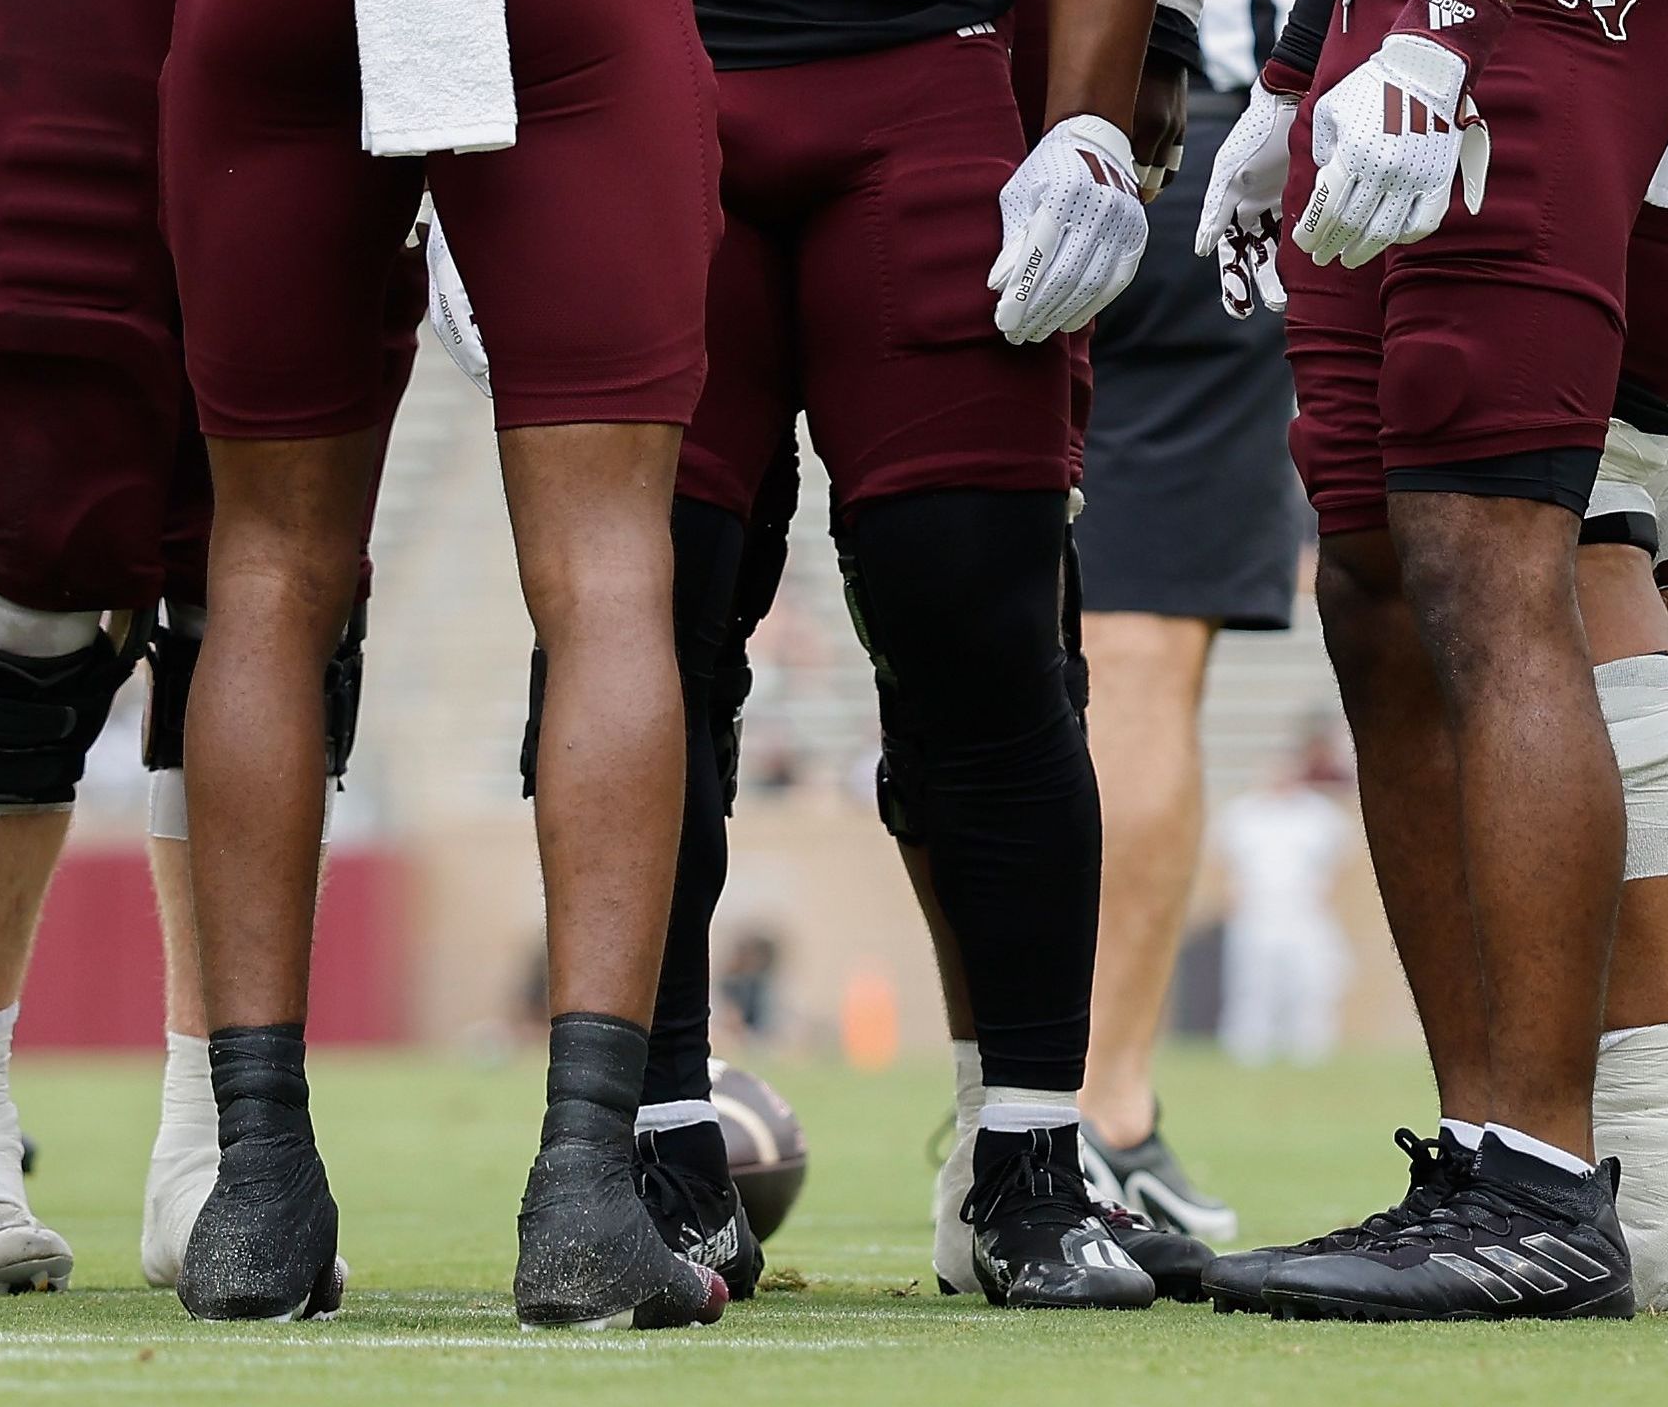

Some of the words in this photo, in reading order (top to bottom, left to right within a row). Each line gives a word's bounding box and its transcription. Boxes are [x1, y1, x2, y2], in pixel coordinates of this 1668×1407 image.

[1303, 180, 1330, 233] ADIZERO
[1015, 245, 1044, 302] ADIZERO
[439, 292, 463, 345] ADIZERO
